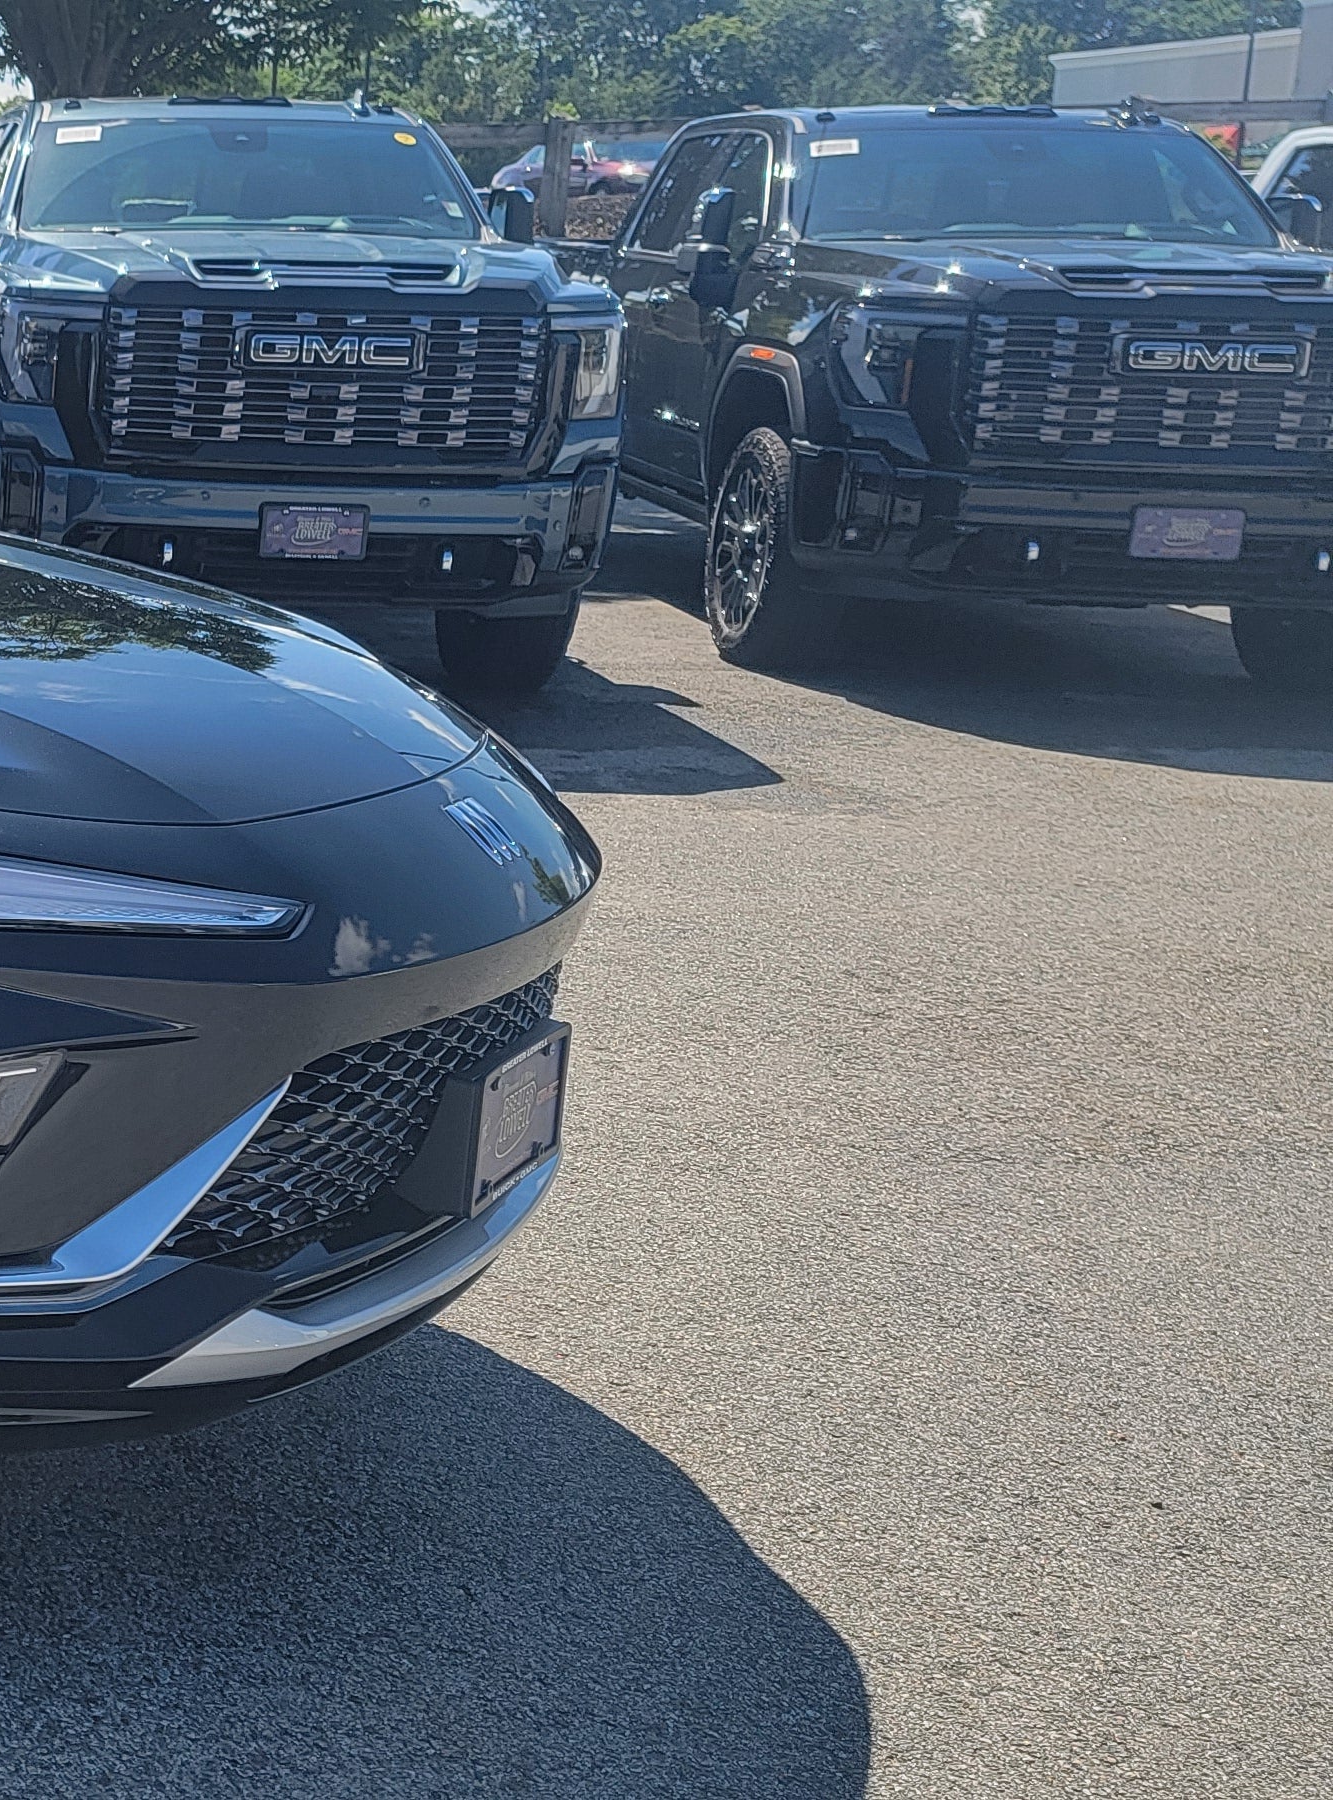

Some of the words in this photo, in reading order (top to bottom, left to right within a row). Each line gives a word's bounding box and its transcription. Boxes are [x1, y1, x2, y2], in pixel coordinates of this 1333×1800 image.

[250, 333, 411, 366] GMC
[1128, 341, 1297, 373] GMC
[295, 529, 331, 540] LOWELL
[501, 1051, 527, 1074] GREATER
[526, 1037, 548, 1058] LOWELL
[492, 1180, 515, 1201] BUICK
[520, 1161, 538, 1179] GMC
